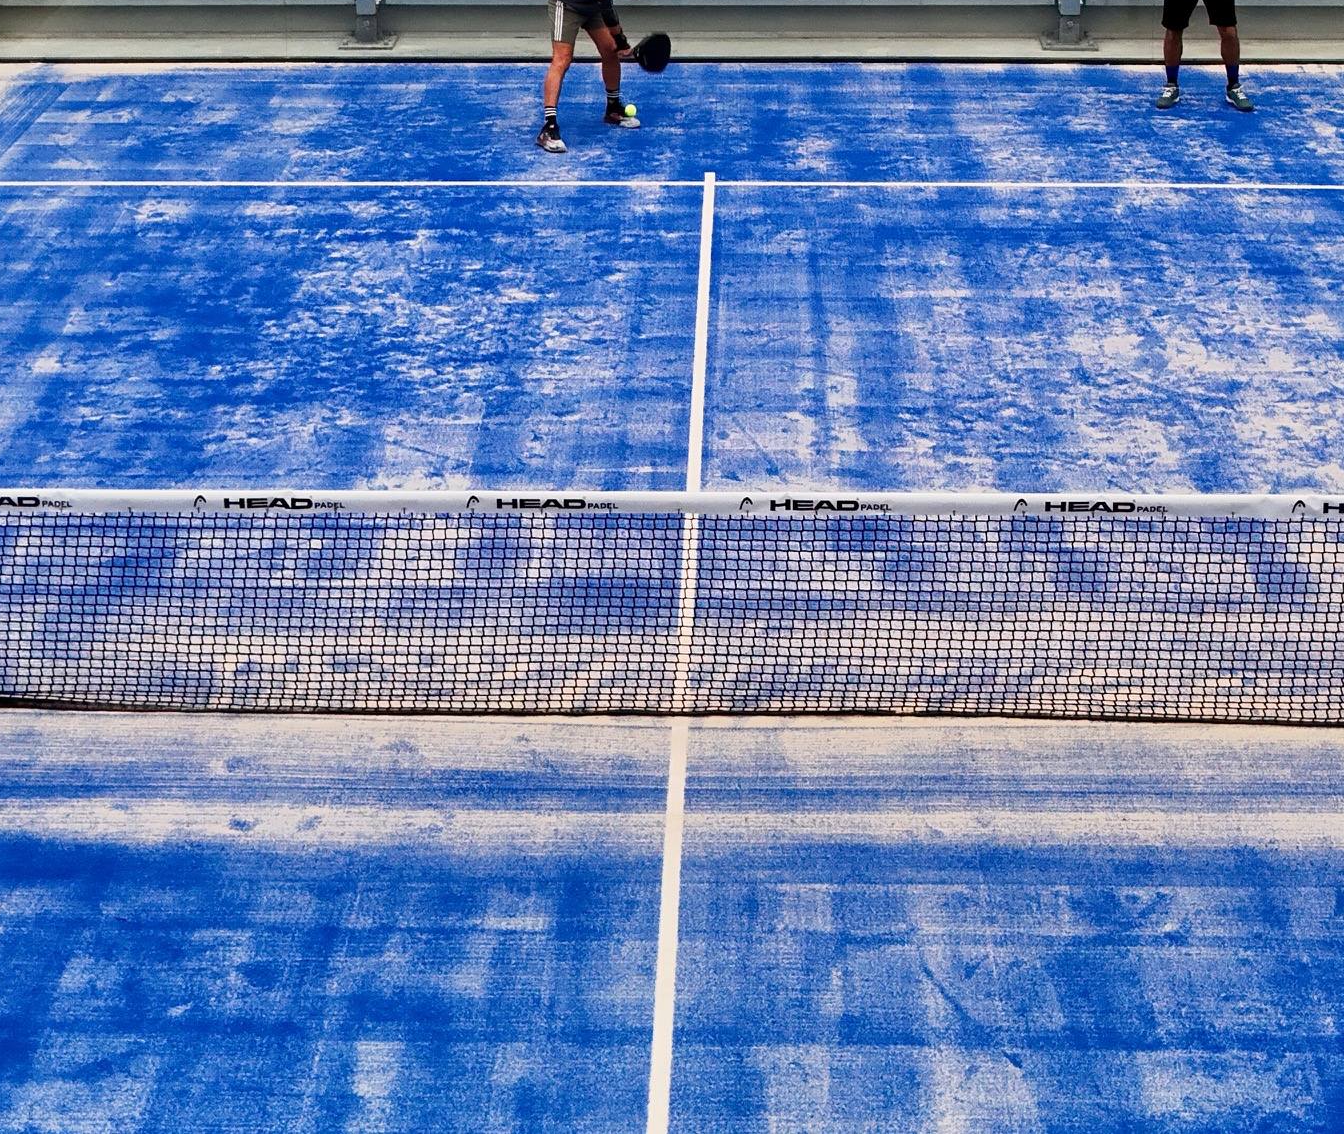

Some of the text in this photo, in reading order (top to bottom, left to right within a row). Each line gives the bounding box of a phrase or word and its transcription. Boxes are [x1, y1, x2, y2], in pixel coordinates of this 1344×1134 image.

[224, 498, 313, 511] HEAD
[497, 499, 586, 512] HEAD
[770, 499, 859, 513] HEAD
[1045, 502, 1135, 515] HEAD
